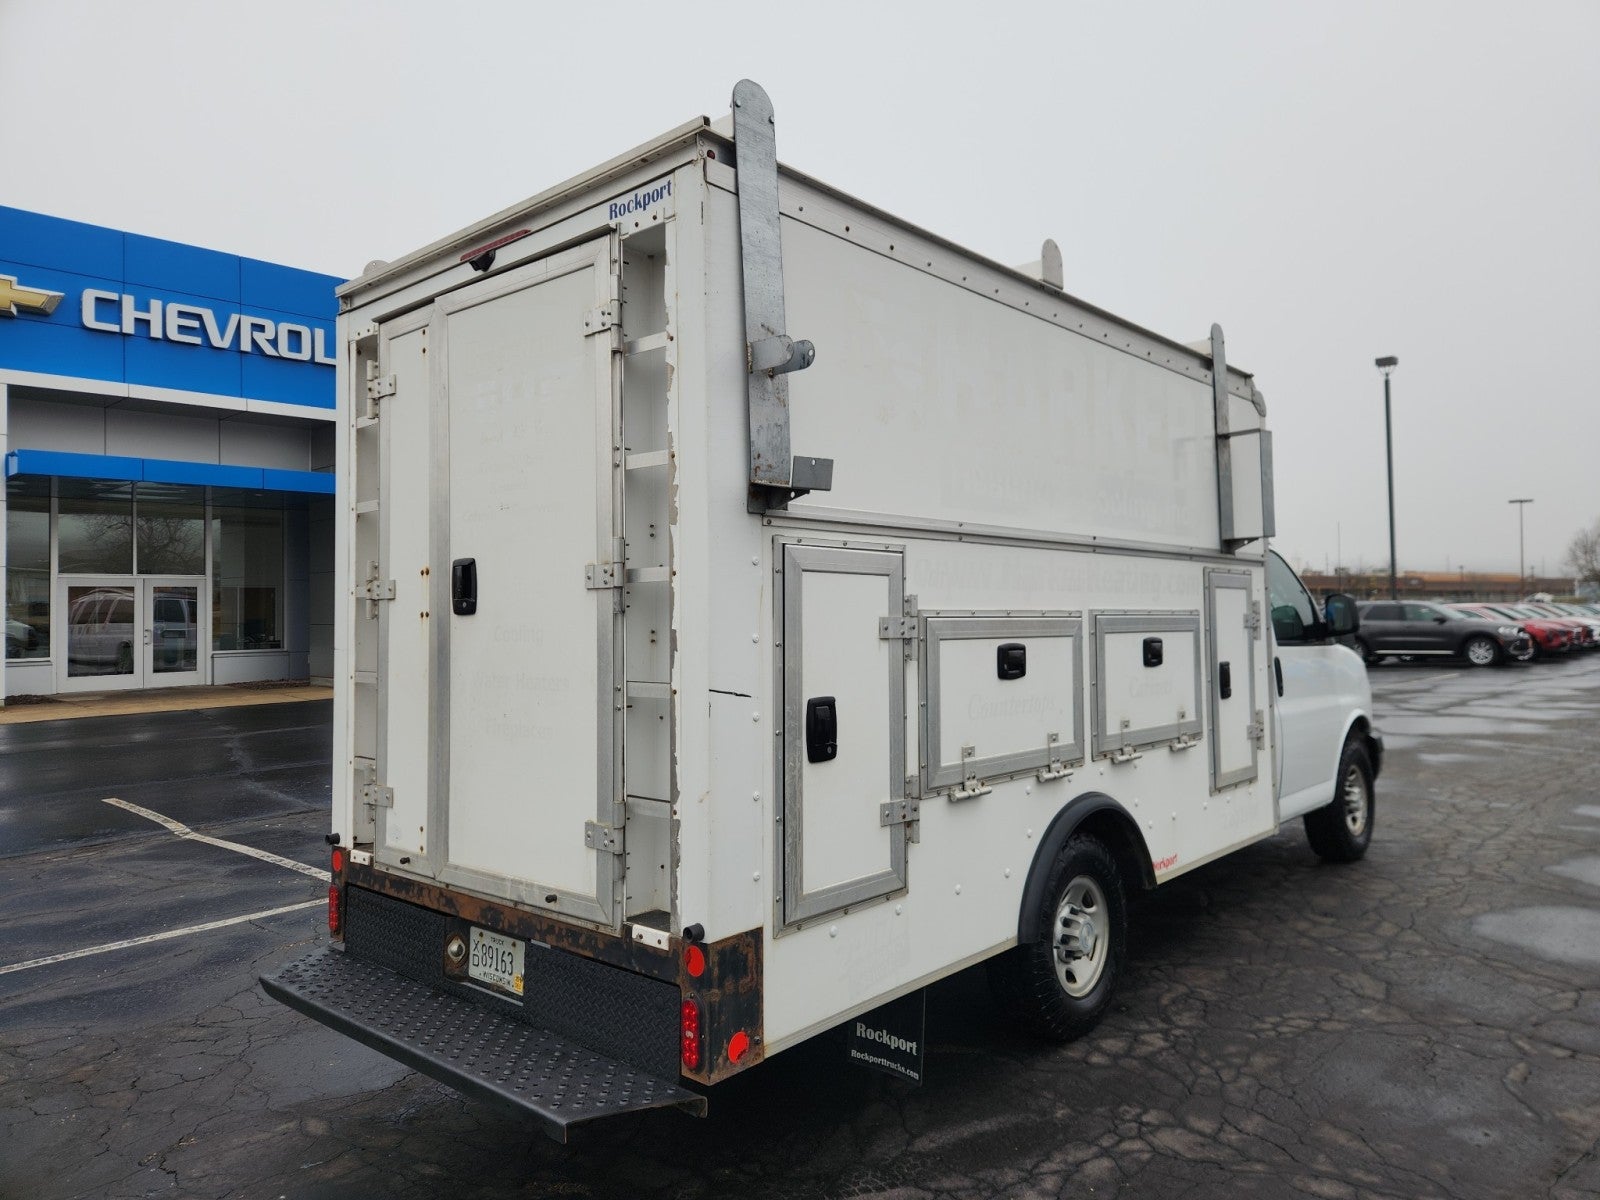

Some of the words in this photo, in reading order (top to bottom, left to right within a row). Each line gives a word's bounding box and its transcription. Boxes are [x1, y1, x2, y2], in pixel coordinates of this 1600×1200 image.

[609, 180, 672, 220] Rockport
[81, 288, 337, 366] CHEVROL
[490, 936, 505, 946] TRUCK
[481, 943, 514, 976] 89163
[856, 1021, 917, 1055] Rockport
[850, 1049, 919, 1080] Rockporttrucks.com
